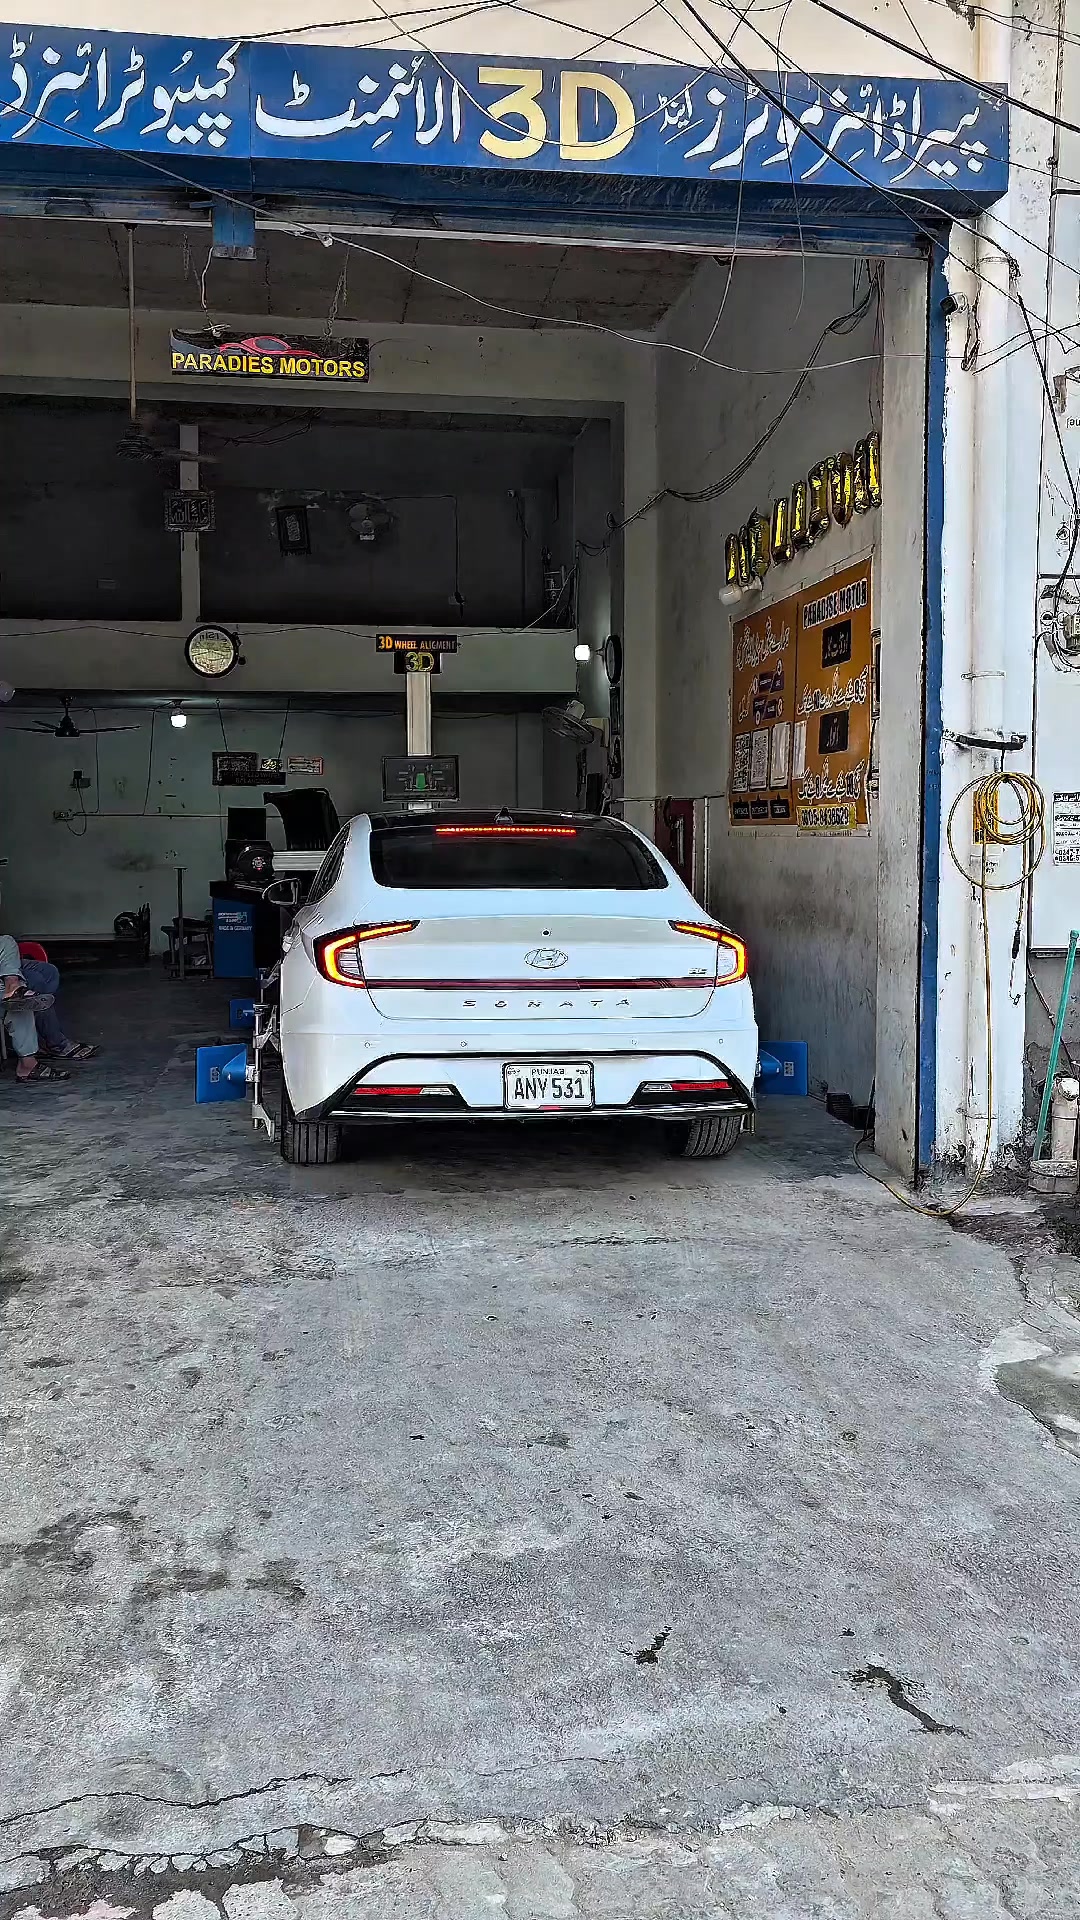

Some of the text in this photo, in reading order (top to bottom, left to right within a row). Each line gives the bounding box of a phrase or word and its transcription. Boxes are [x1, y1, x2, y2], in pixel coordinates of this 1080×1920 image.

[478, 65, 636, 161] 3D
[172, 352, 365, 378] PARADIES MOTORS
[840, 579, 867, 612] MOTOR
[378, 635, 393, 649] 3D
[394, 640, 418, 650] WHEEL
[405, 651, 435, 672] 3D
[462, 998, 632, 1008] SONATA
[514, 1077, 585, 1099] ANY 531
